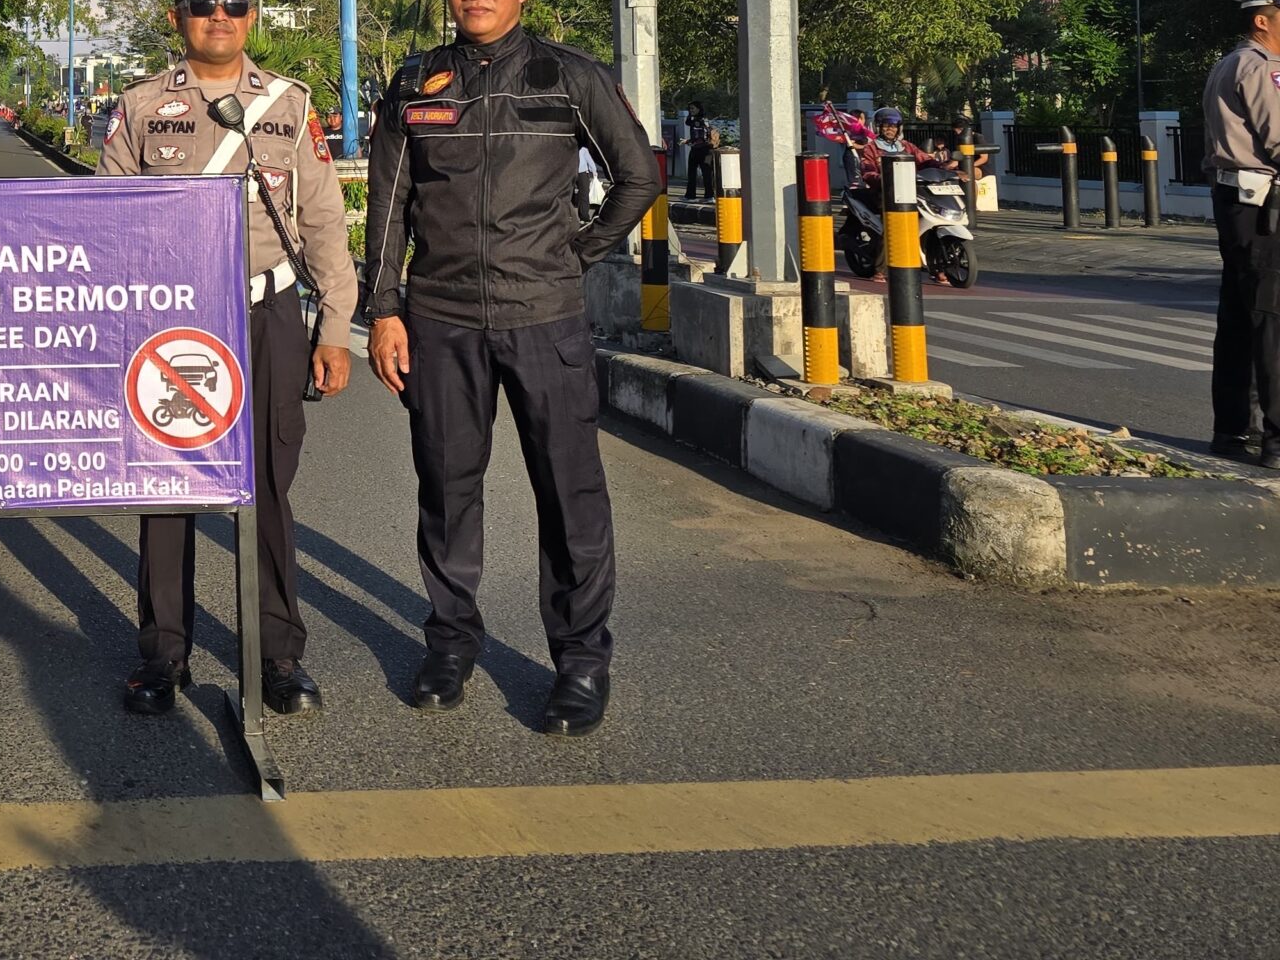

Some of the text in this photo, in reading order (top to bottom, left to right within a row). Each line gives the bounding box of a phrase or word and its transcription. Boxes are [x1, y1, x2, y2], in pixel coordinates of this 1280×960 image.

[147, 119, 196, 135] SOFYAN
[251, 121, 296, 140] POLRI
[13, 284, 196, 313] BERMOTOR
[34, 323, 98, 352] DAY)
[4, 408, 121, 432] DILARANG
[43, 451, 106, 473] 09.00
[57, 476, 138, 501] Pejalan
[142, 475, 191, 497] Kaki
